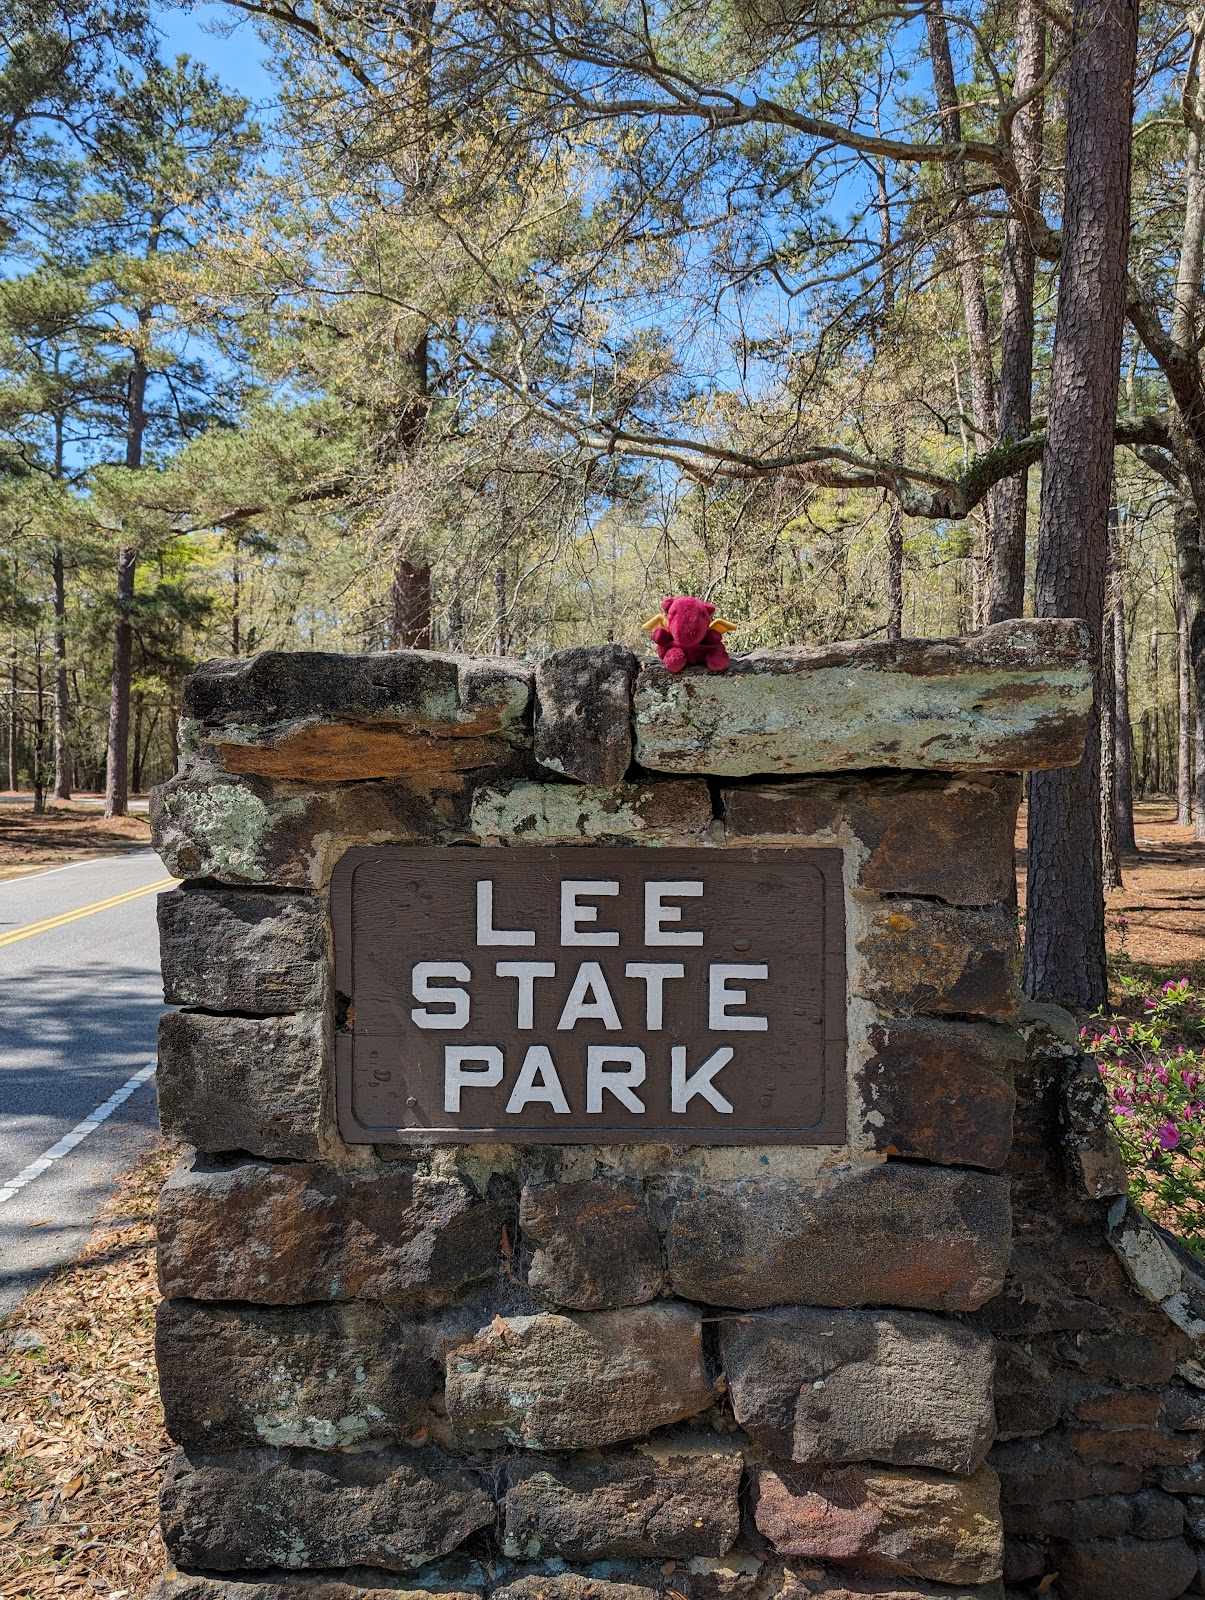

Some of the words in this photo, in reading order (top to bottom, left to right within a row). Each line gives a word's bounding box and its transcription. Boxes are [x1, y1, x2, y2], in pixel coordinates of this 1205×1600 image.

[476, 880, 704, 946] LEE
[411, 961, 768, 1031] STATE
[444, 1045, 734, 1114] PARK
